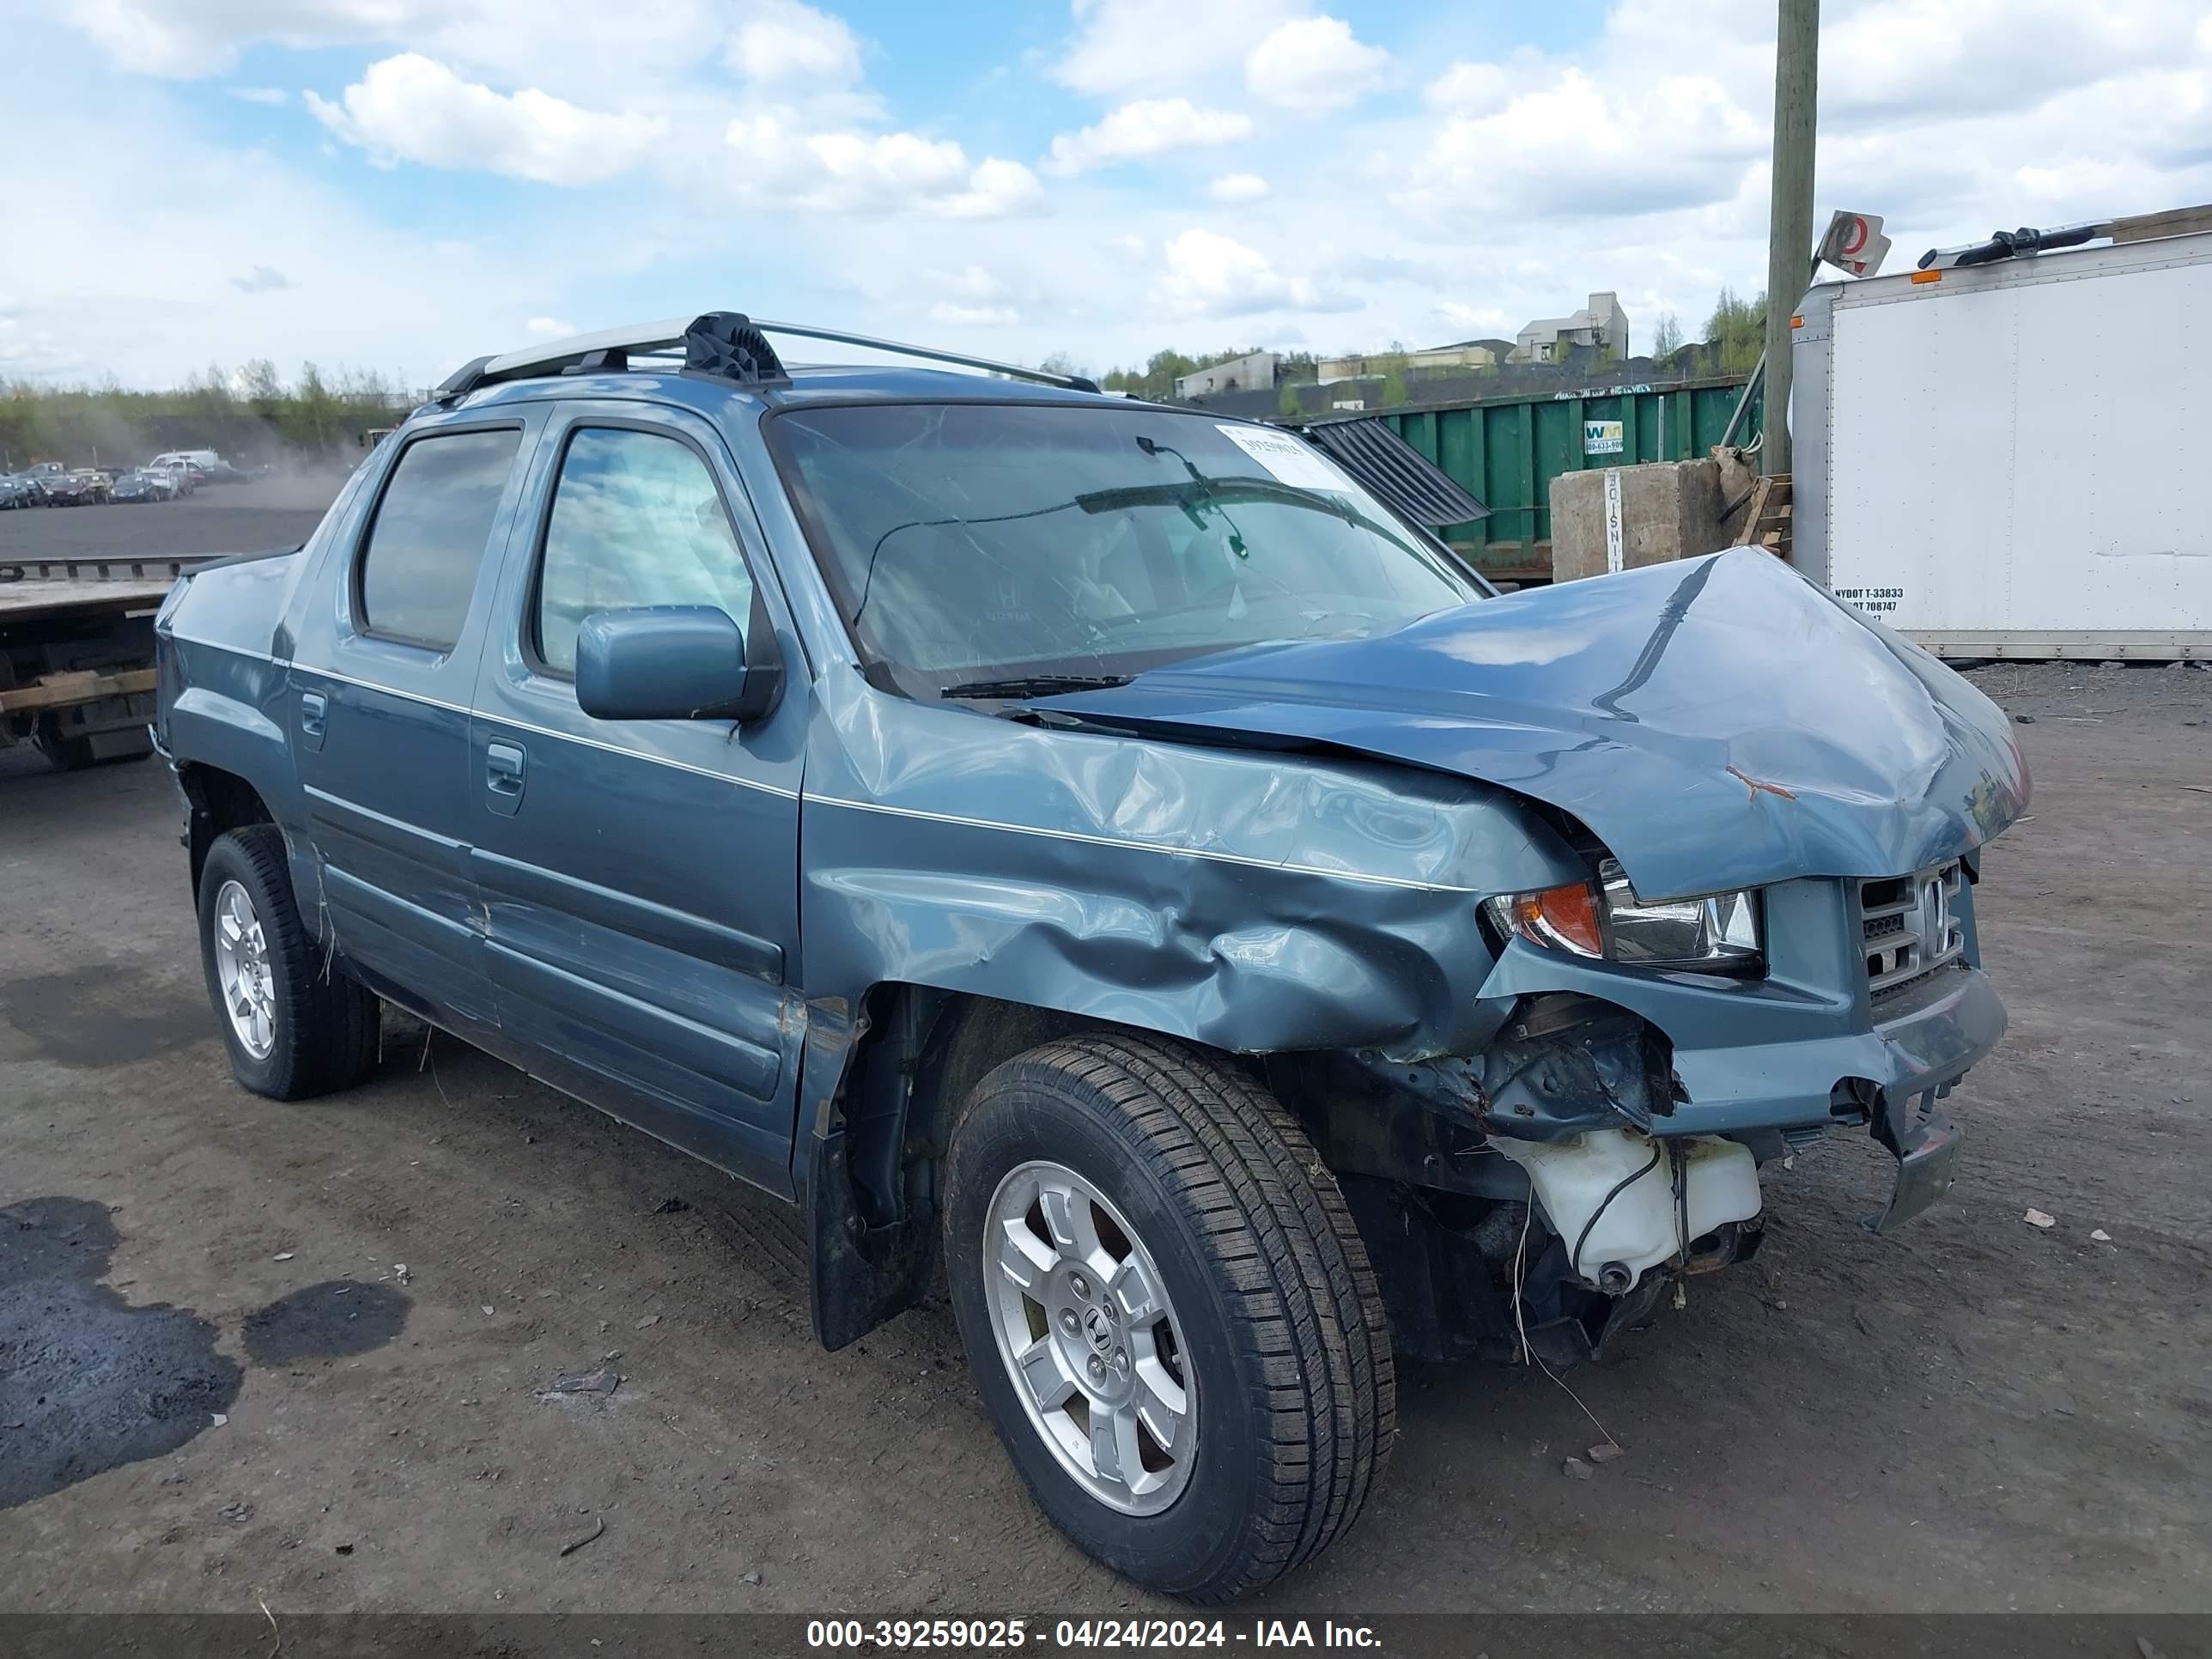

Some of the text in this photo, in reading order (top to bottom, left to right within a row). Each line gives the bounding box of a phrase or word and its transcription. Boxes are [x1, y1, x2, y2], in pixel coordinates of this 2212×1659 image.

[1835, 588, 1903, 599] NYDOT T-33833
[1867, 602, 1896, 611] 708747
